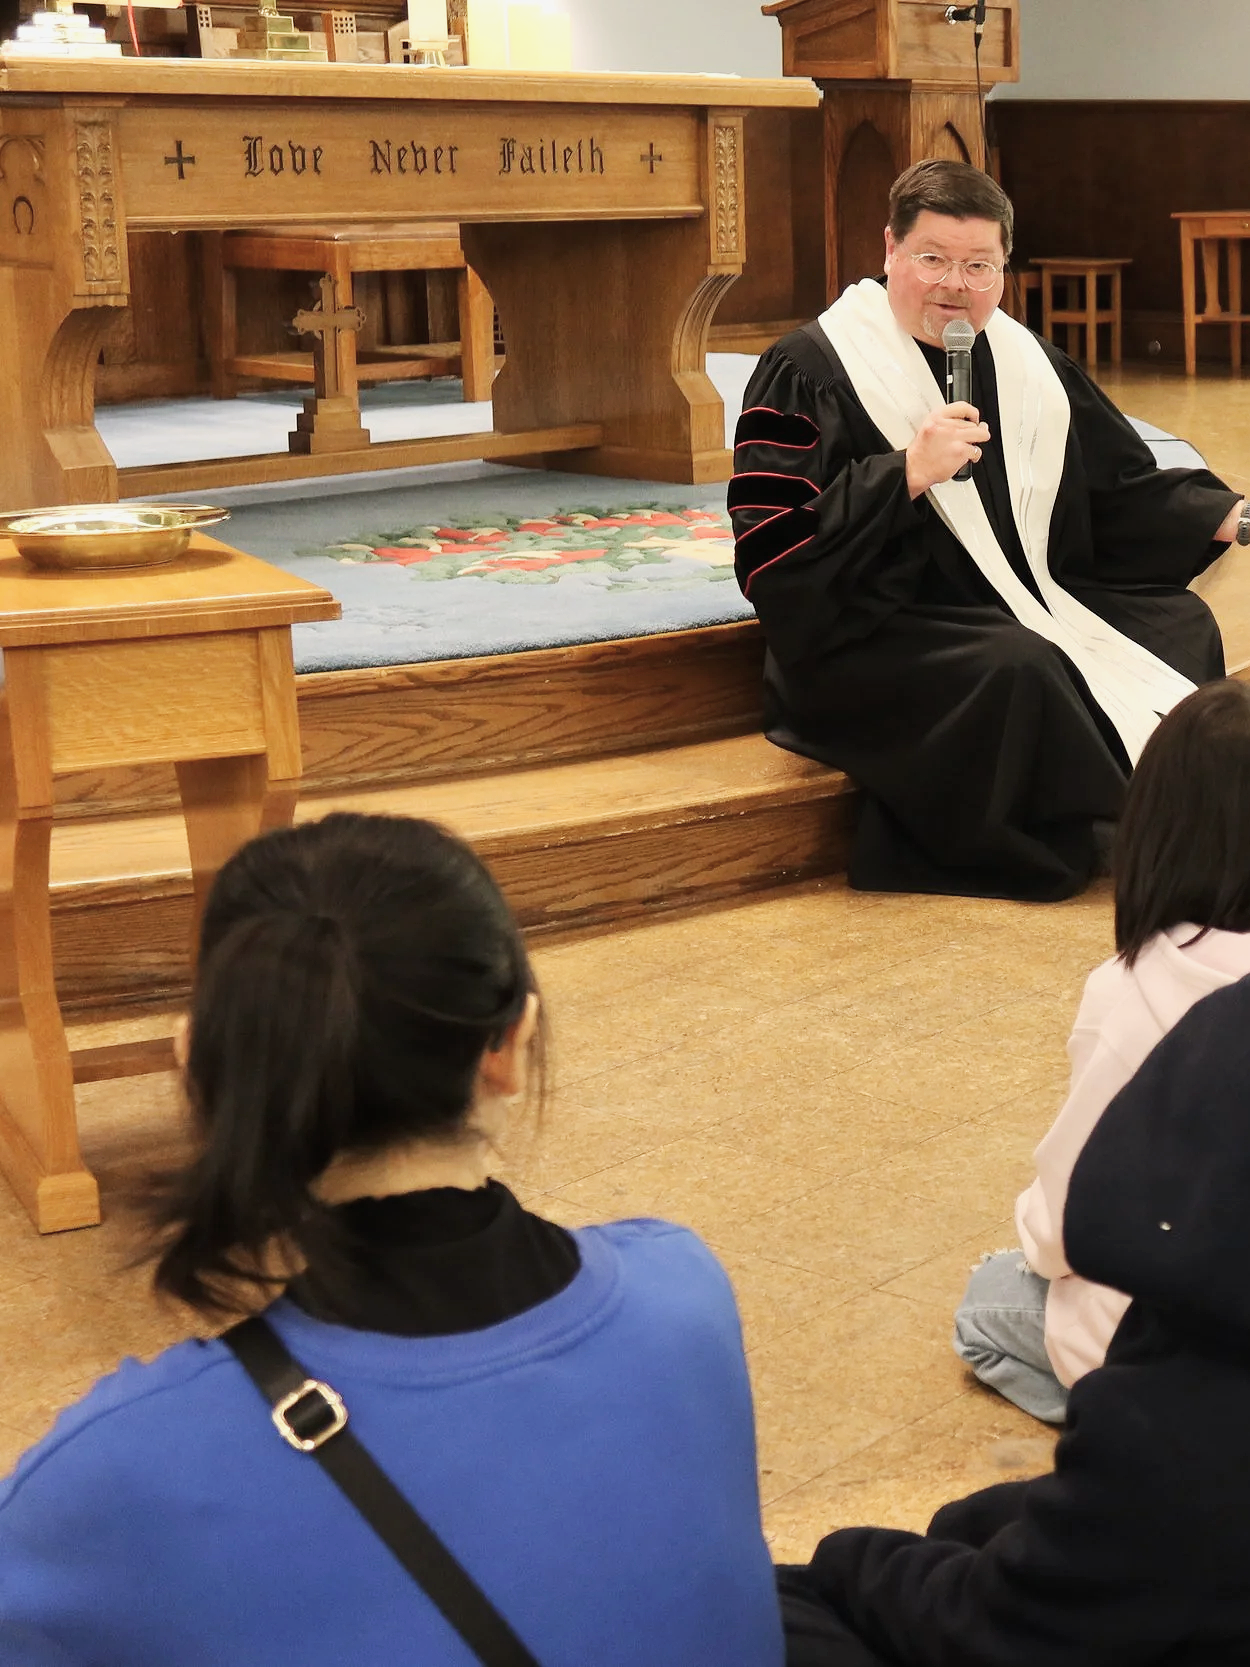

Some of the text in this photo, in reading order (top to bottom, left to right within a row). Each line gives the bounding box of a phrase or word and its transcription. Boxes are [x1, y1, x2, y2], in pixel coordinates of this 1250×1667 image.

[242, 135, 605, 178] Love Never Faileth
